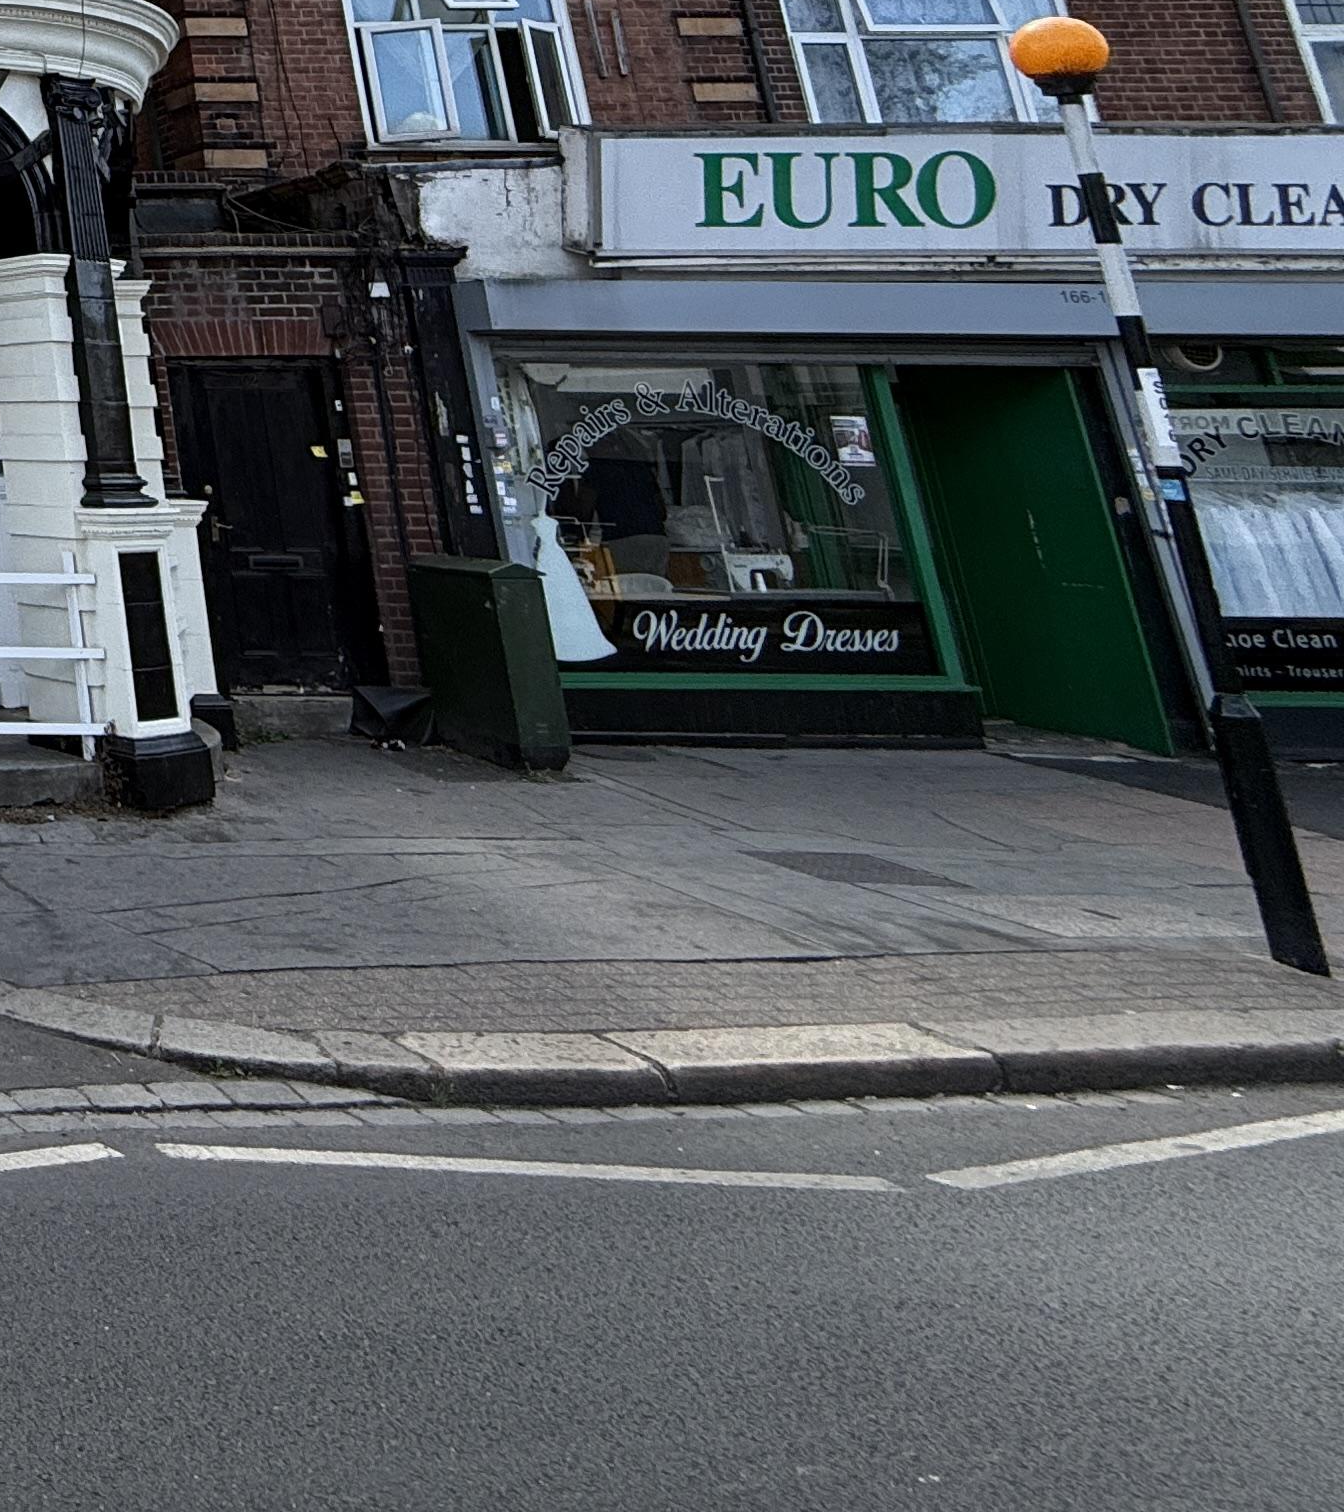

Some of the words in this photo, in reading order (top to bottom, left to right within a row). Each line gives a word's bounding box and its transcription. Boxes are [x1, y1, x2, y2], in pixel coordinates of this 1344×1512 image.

[694, 150, 998, 229] EURO
[1045, 183, 1166, 227] DRY
[525, 397, 632, 501] Repairs
[635, 381, 670, 416] &
[675, 379, 866, 506] Alterations
[632, 609, 768, 663] Wedding
[780, 610, 900, 653] Dresses
[1272, 629, 1338, 648] Clean
